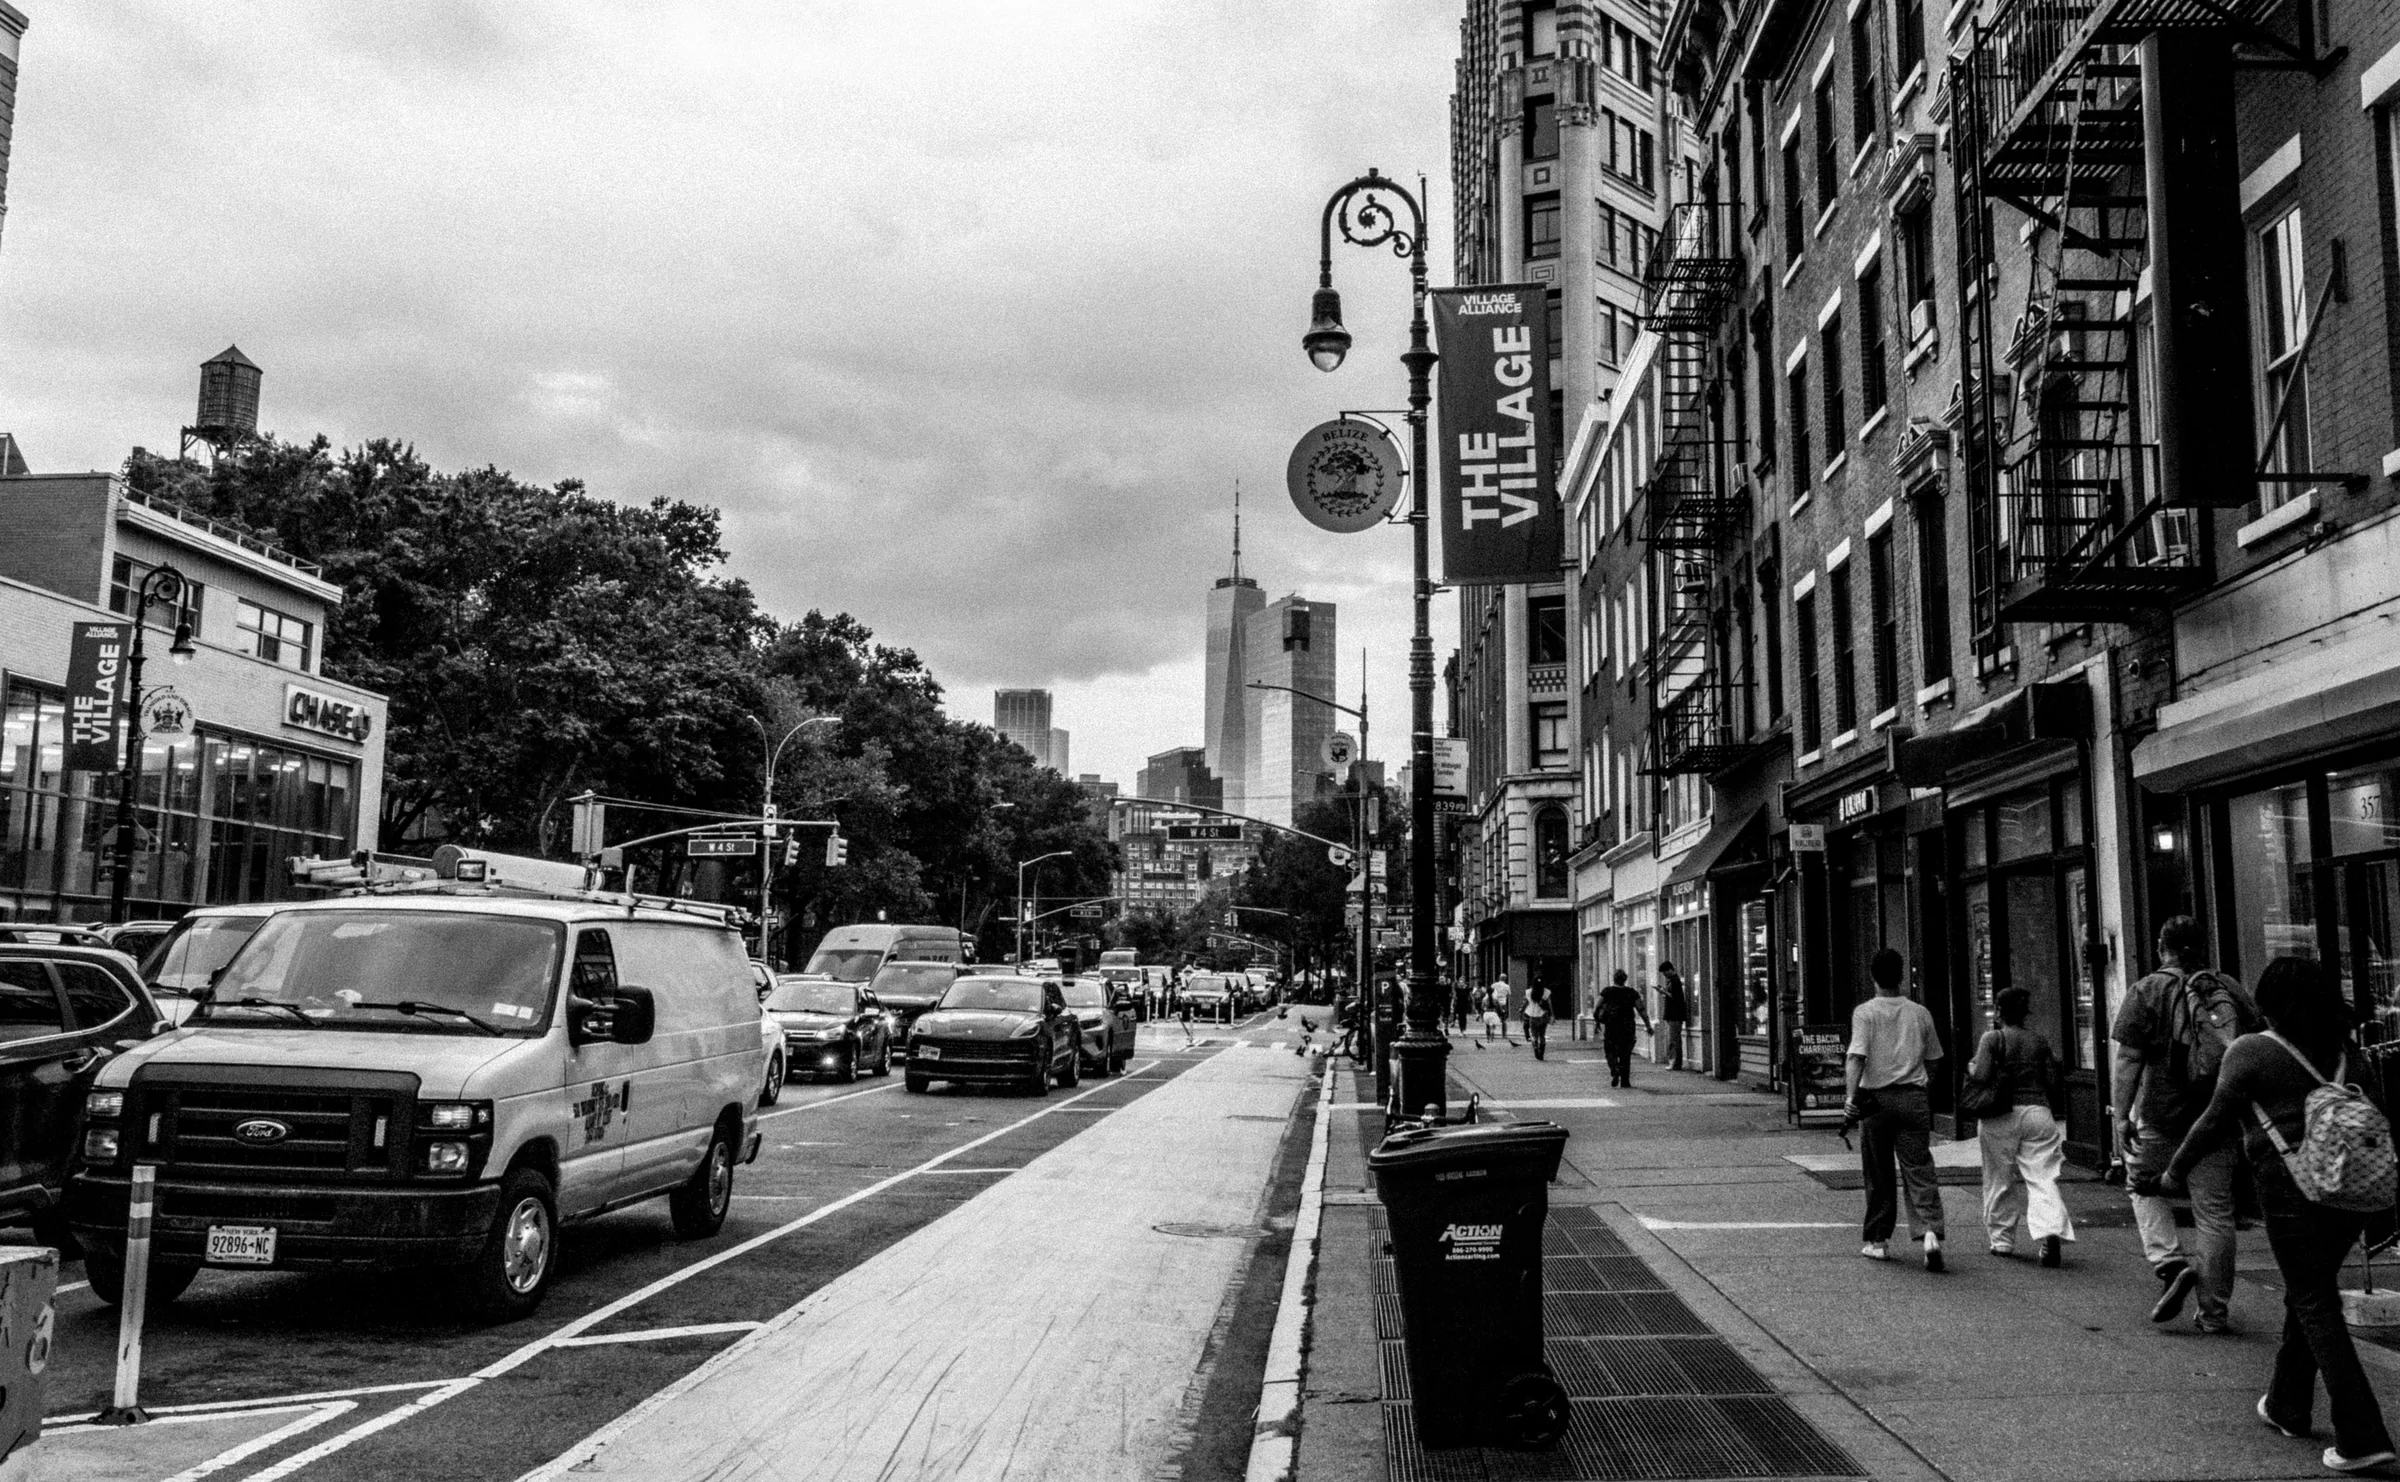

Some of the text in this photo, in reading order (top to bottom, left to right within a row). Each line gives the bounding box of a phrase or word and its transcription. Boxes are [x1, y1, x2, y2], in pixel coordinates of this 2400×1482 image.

[1463, 294, 1516, 305] VILLAGE
[1458, 303, 1522, 315] ALLIANCE
[1492, 326, 1539, 529] VILLAGE
[1322, 429, 1369, 441] BELIZE
[1459, 432, 1500, 530] THE
[85, 631, 119, 639] ALLIANCE
[91, 644, 120, 745] VILLAGE
[144, 694, 166, 717] TRINIDAD
[72, 696, 94, 744] THE
[289, 691, 353, 737] CHASE
[1433, 801, 1456, 812] 839
[2361, 795, 2381, 820] 357
[1190, 827, 1219, 838] W 4 St
[708, 843, 735, 852] W 4 St
[1381, 981, 1390, 994] P
[1802, 1033, 1840, 1044] THE BACON
[1799, 1044, 1846, 1054] CHARBURGER
[246, 1124, 275, 1137] Ford
[1438, 1223, 1503, 1242] ACTION
